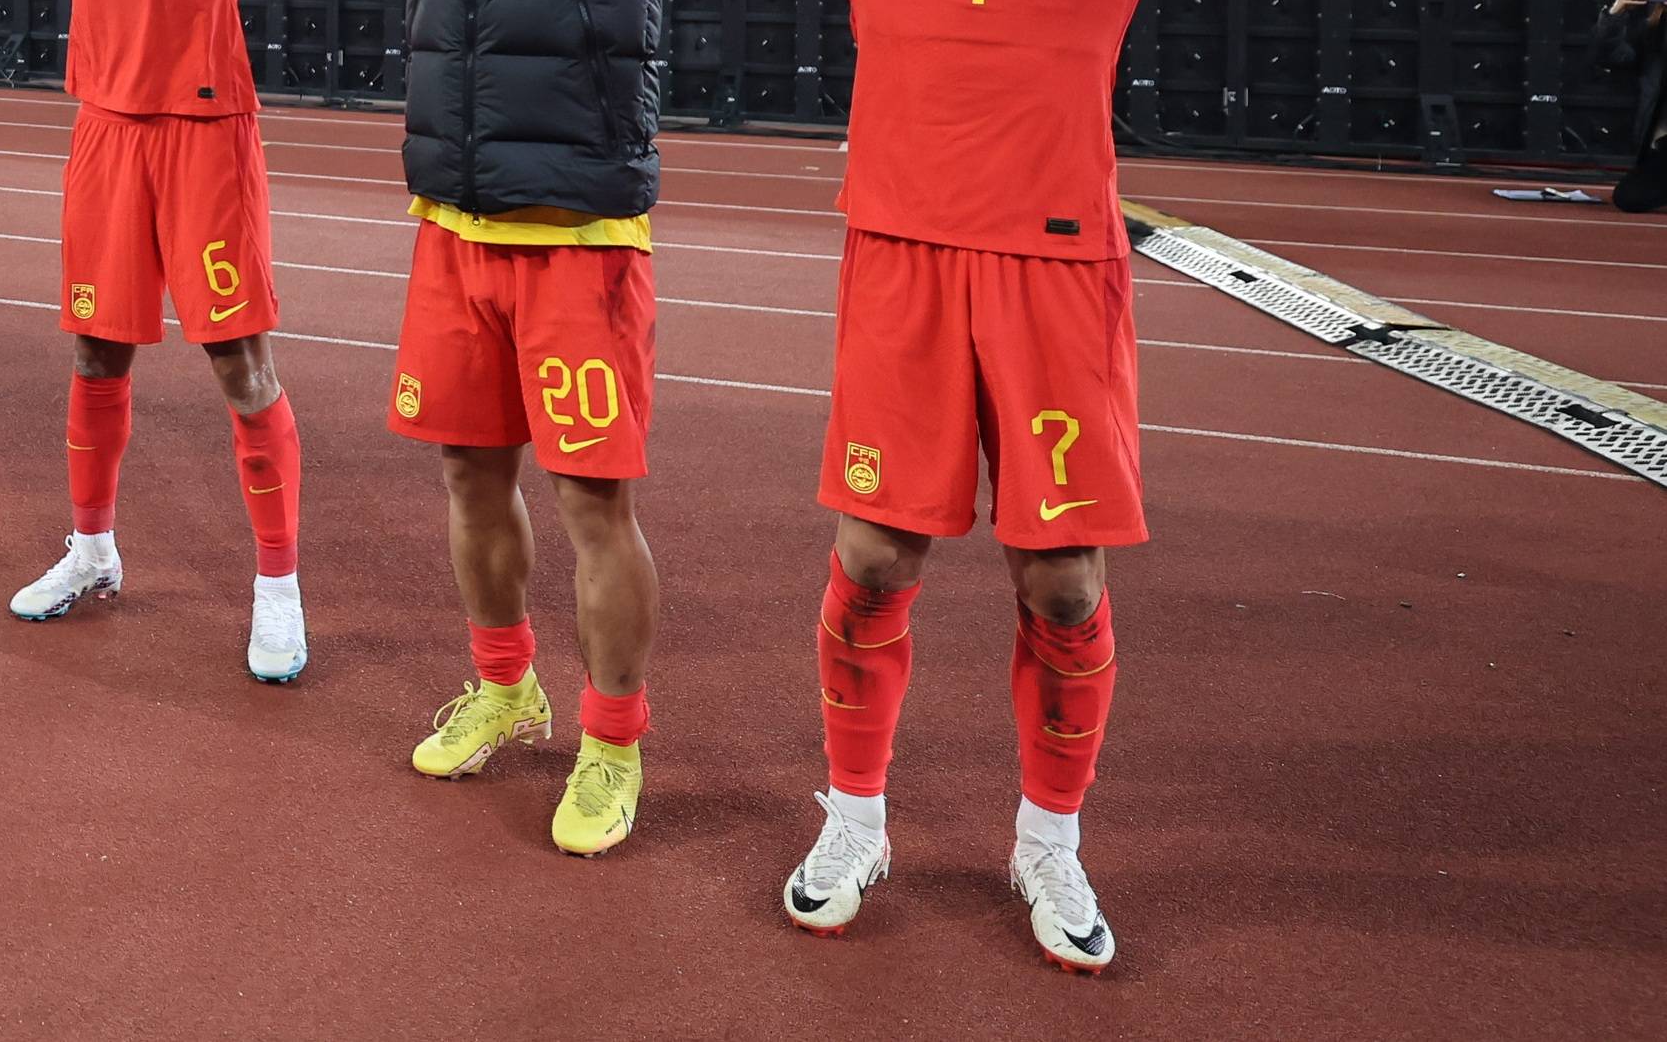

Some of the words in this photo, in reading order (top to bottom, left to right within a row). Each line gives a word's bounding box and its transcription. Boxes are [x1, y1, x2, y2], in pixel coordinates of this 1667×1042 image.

[201, 240, 240, 297] 6
[537, 356, 620, 428] 20
[850, 446, 878, 461] CFA
[1031, 409, 1080, 486] 7
